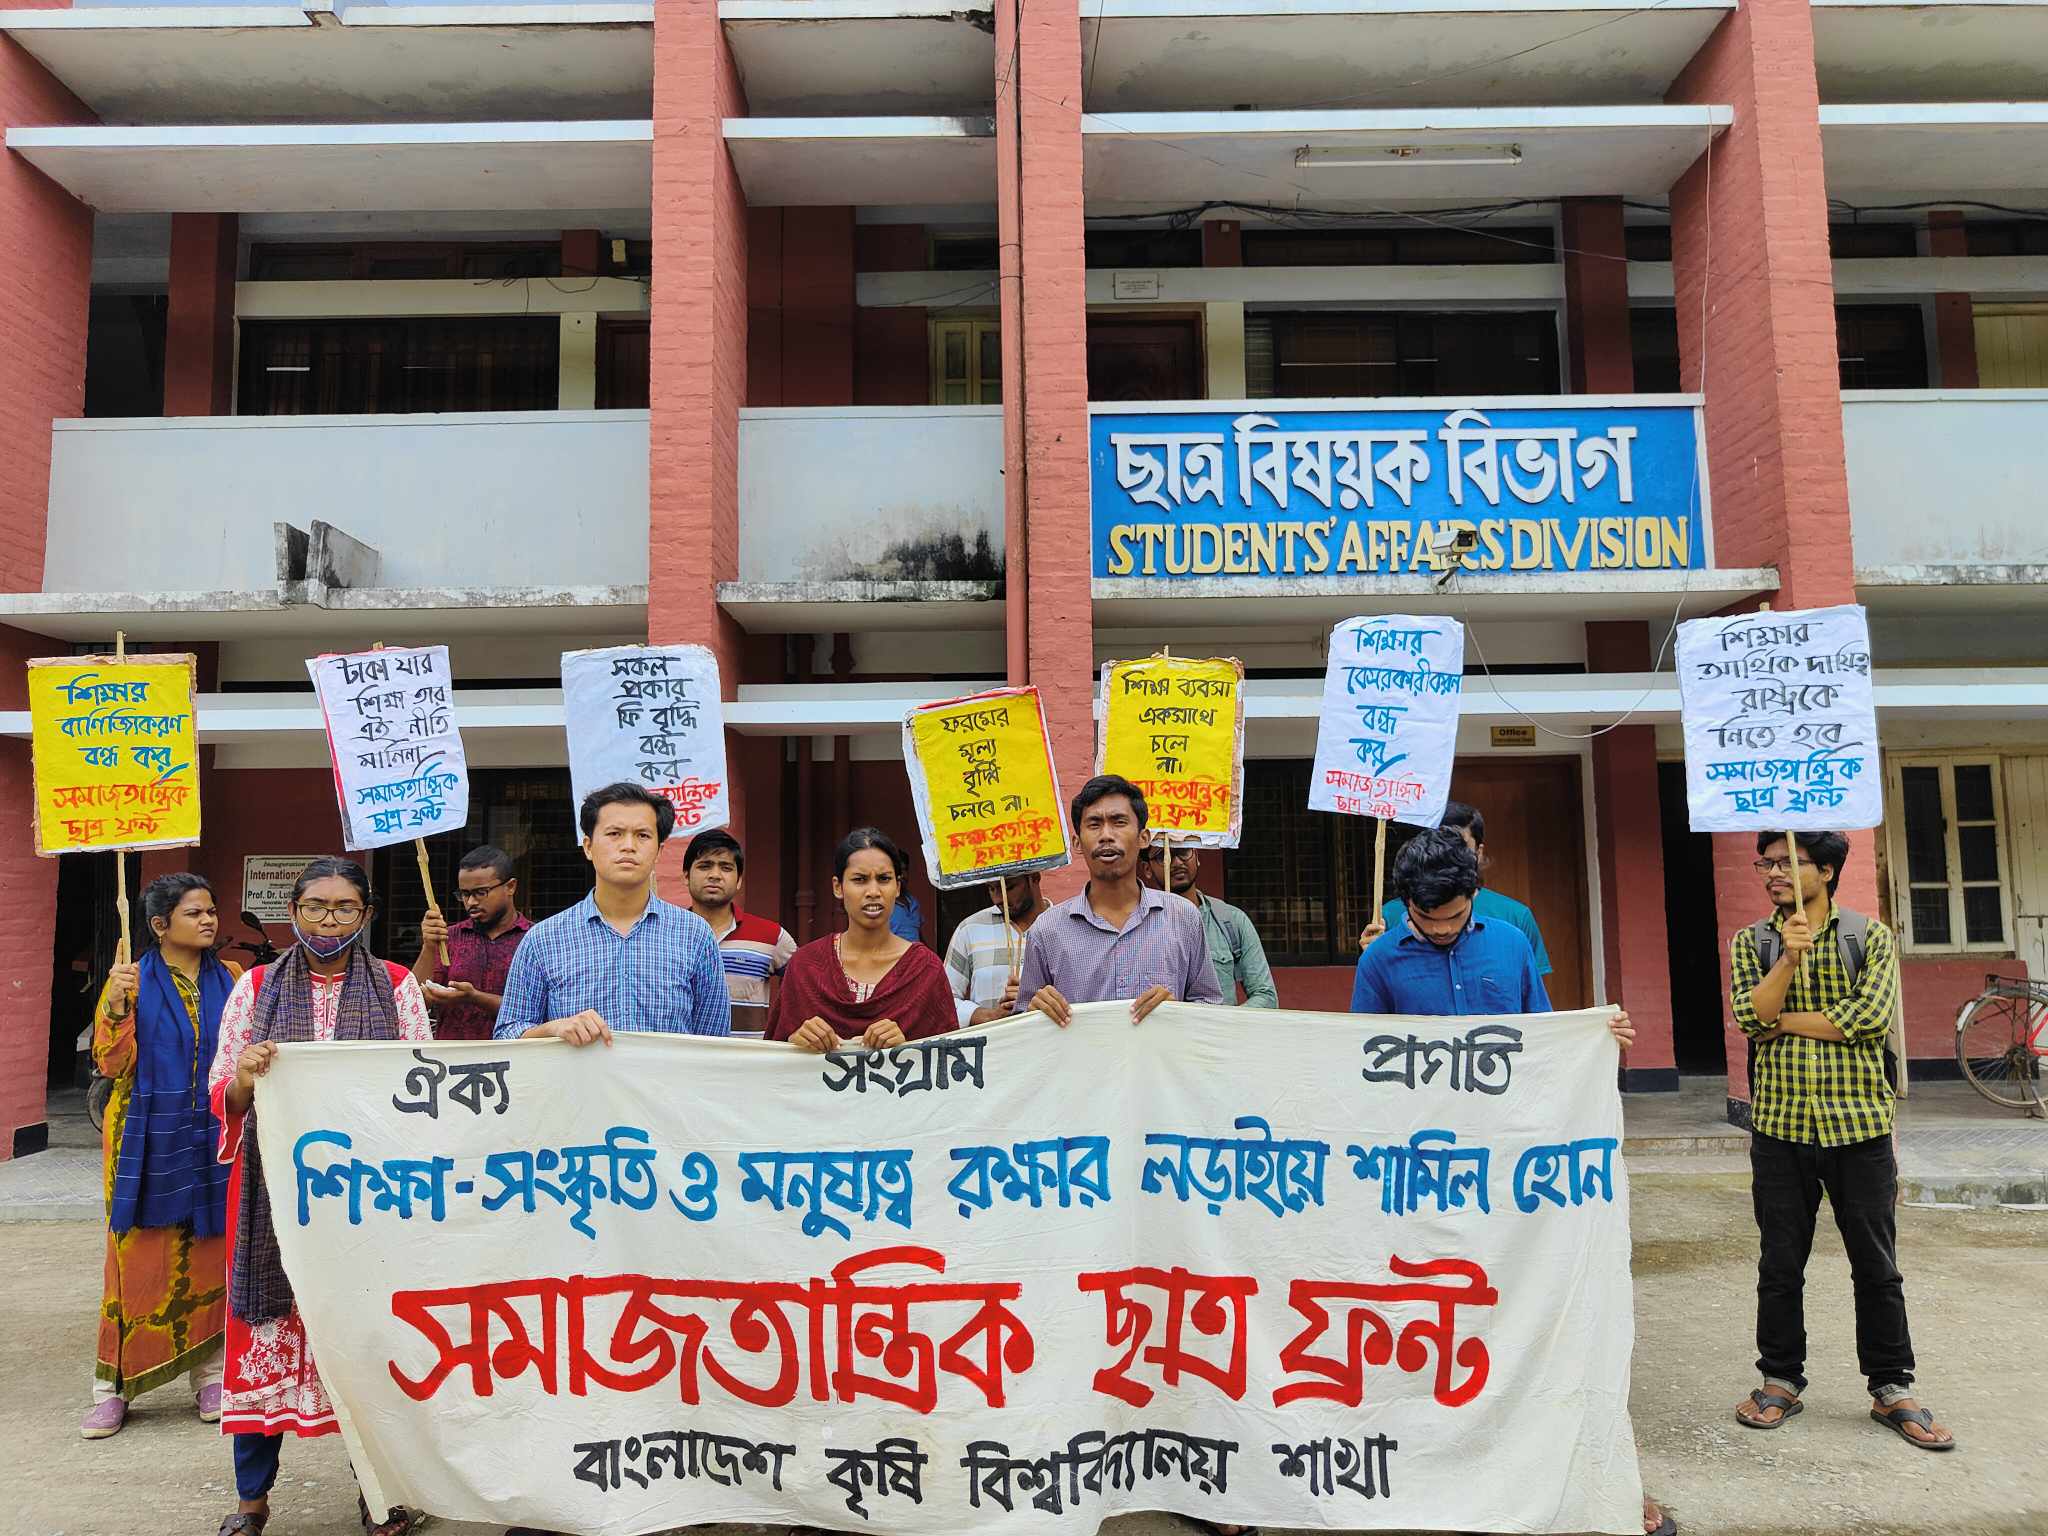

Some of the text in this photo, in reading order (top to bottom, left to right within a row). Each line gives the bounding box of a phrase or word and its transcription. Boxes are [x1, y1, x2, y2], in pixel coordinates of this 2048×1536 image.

[1111, 409, 1638, 511] ছাত্র বিষয়ক বিভাগ
[1508, 516, 1688, 571] DIVISION
[1350, 620, 1442, 657] শিক্ষার
[1713, 618, 1823, 651] শিক্ষার
[396, 654, 433, 676] যার
[611, 656, 681, 677] সকল
[1697, 648, 1799, 680] আর্থিক
[56, 673, 149, 705] শিক্ষার
[347, 684, 445, 715] শিক্ষা তার
[612, 679, 693, 701] প্রকার
[1176, 678, 1234, 698] ব্যবসা
[1731, 677, 1844, 715] রাষ্ট্রকে
[409, 707, 450, 737] নীতি
[616, 700, 700, 735] ফি বৃদ্ধি
[1139, 707, 1218, 727] একসাথে
[1356, 705, 1408, 735] বন্ধ
[1499, 728, 1528, 736] Office
[639, 733, 686, 756] বন্ধ
[1149, 734, 1189, 754] চলে
[1707, 715, 1848, 750] নিতে হবে
[79, 746, 119, 767] বন্ধ
[958, 739, 997, 763] মূল্য
[635, 759, 692, 784] কর
[947, 800, 995, 821] চলবে
[1725, 786, 1778, 813] ছাত্র
[250, 869, 304, 880] Internationa
[247, 890, 265, 899] Prof.
[822, 1035, 987, 1098] সংগ্রাম
[1362, 1024, 1524, 1096] প্রগতি
[392, 1047, 510, 1120] ঐক্য
[668, 1149, 722, 1223] ও
[737, 1148, 914, 1241] মনুষ্যত্ব
[946, 1134, 1112, 1219] রক্ষার
[1140, 1115, 1331, 1218] লড়াইয়ে
[1346, 1129, 1491, 1217] শামিল
[1513, 1135, 1619, 1216] হোন
[388, 1244, 1499, 1416] সমাজতান্ত্রিক ছাত্র ফ্রন্ট
[573, 1427, 1399, 1521] বাংলাদেশ কৃষি বিশ্ববিদ্যালয় শাখা
